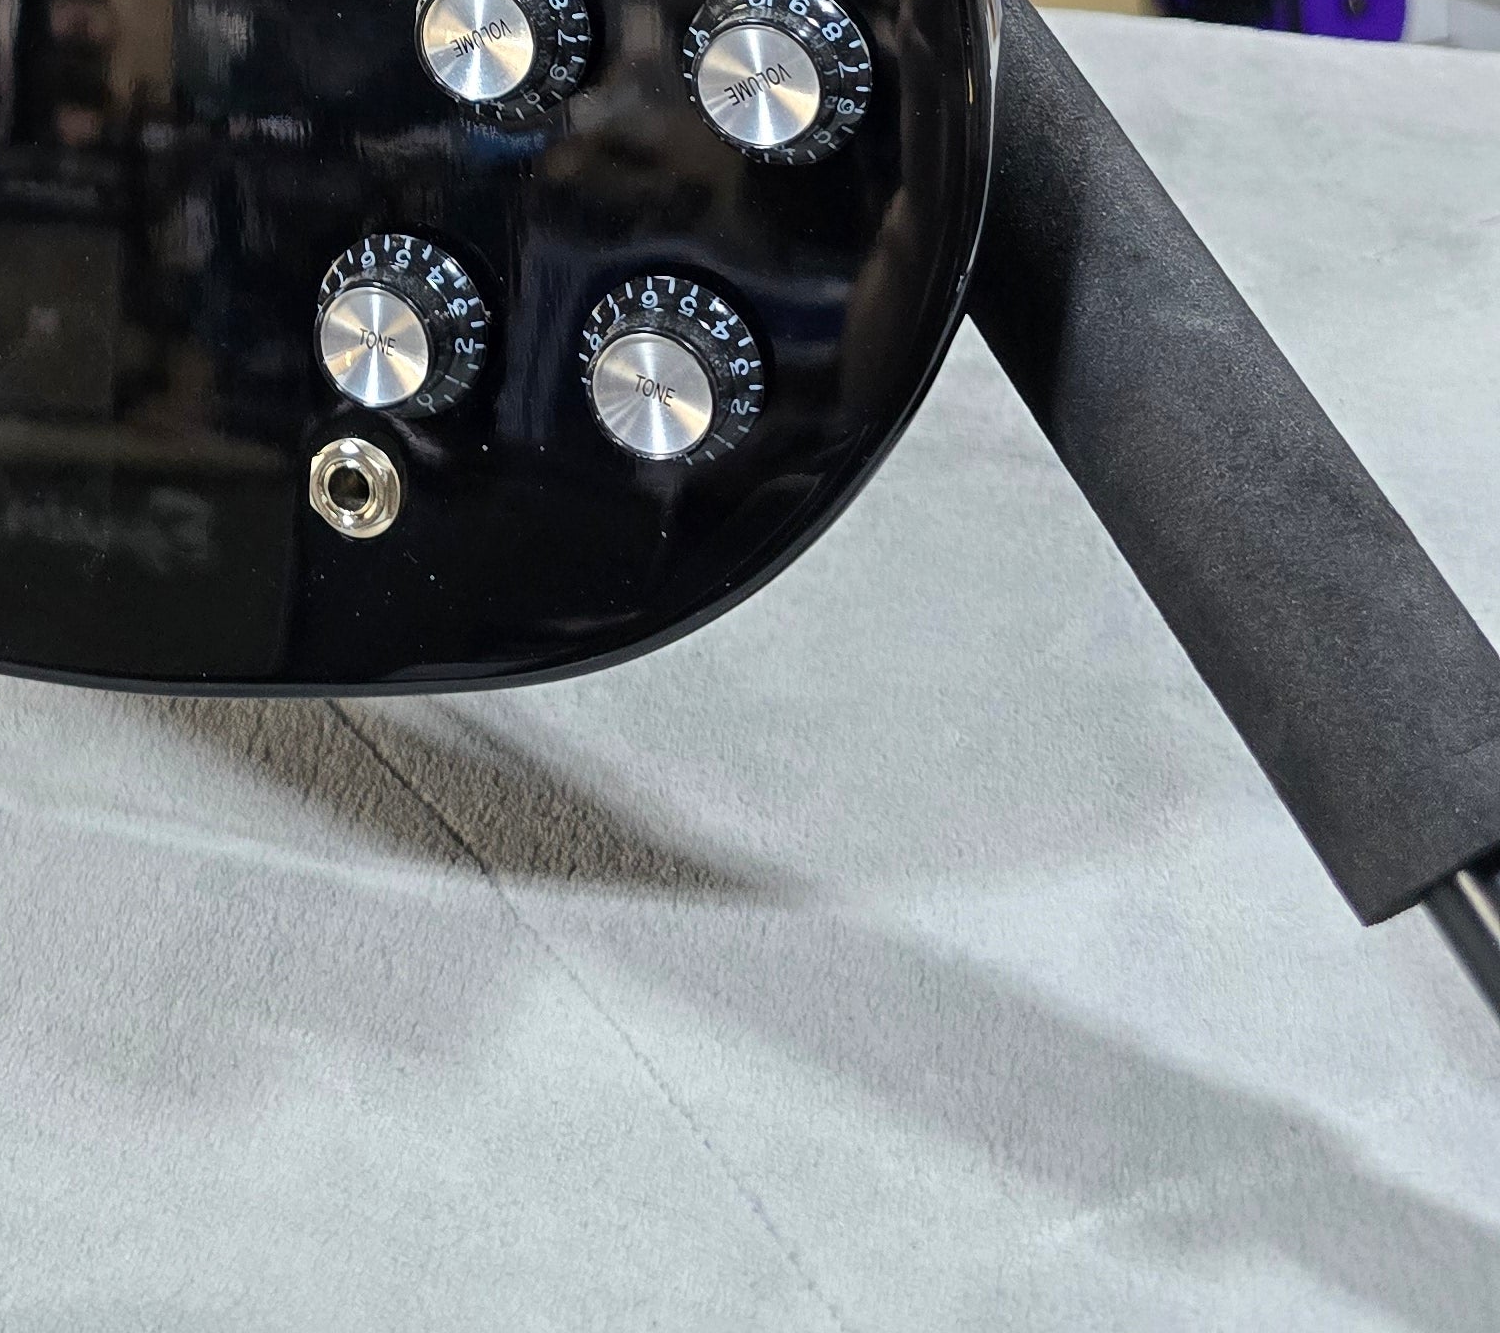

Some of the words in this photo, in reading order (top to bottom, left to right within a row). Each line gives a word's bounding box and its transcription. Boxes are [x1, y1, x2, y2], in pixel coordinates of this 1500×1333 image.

[449, 18, 512, 58] VOLUME
[821, 21, 843, 42] 8
[723, 63, 792, 107] VOLUME
[359, 327, 396, 357] TONE
[635, 374, 676, 408] TONE
